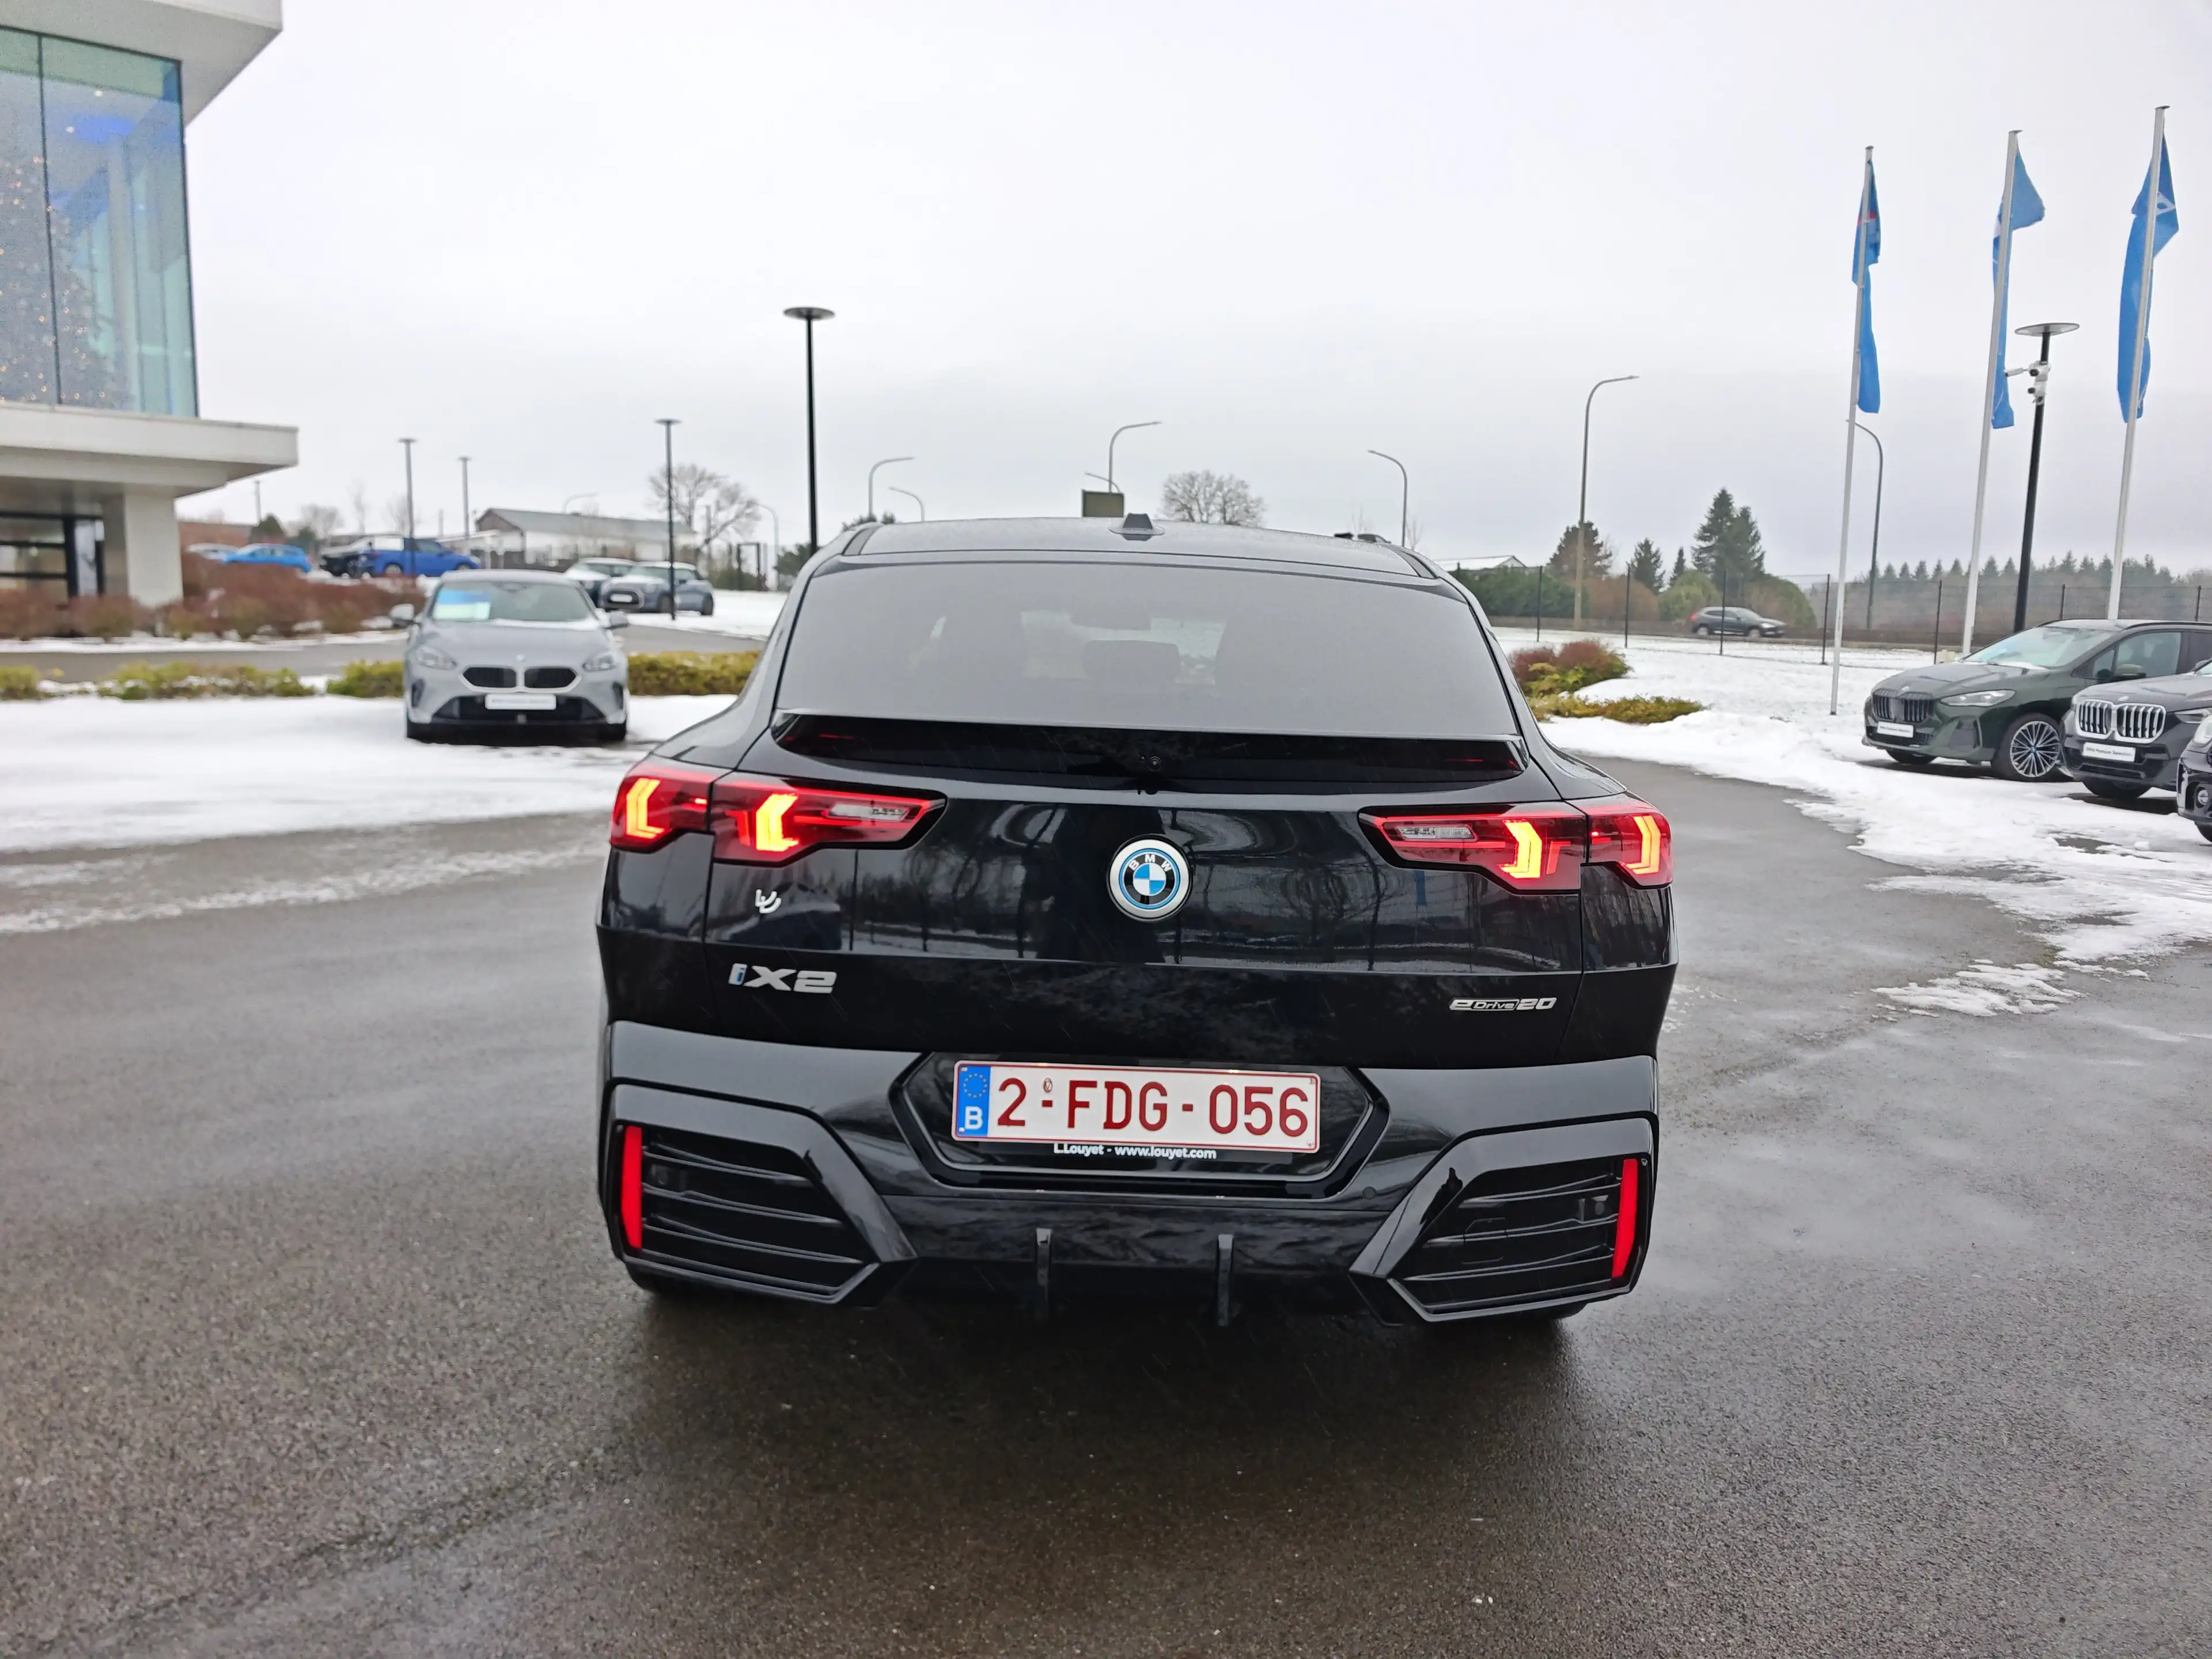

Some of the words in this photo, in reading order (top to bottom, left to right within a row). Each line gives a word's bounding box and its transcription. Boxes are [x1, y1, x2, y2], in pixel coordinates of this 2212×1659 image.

[1128, 854, 1172, 872] BMW
[728, 963, 837, 994] iX2
[1449, 997, 1557, 1012] eDrive20
[964, 1105, 983, 1130] B
[1054, 1142, 1104, 1157] L.Louyet
[1114, 1145, 1217, 1160] www.louyet.com
